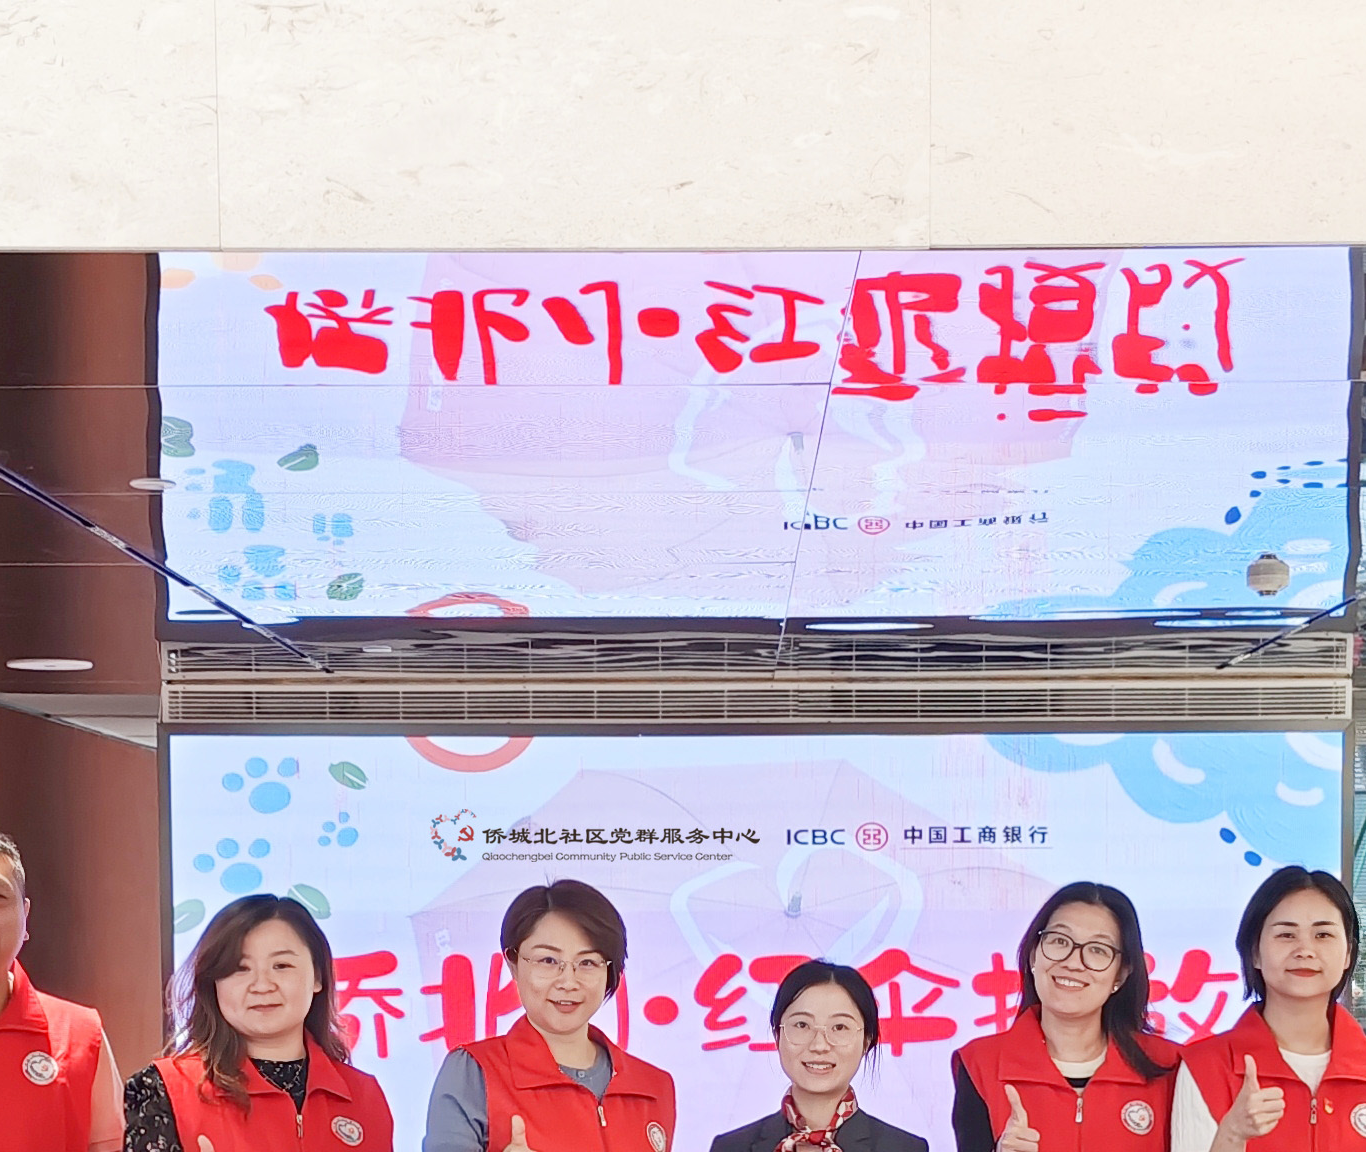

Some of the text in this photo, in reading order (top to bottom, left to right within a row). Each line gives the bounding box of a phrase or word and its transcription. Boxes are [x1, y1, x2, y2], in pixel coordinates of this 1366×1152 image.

[482, 827, 761, 845] 侨城北社区党群服务中心
[786, 828, 846, 846] ICBC
[903, 825, 1050, 845] 中国工商银行
[482, 851, 733, 862] Qiaochengbei Community Public Service Center
